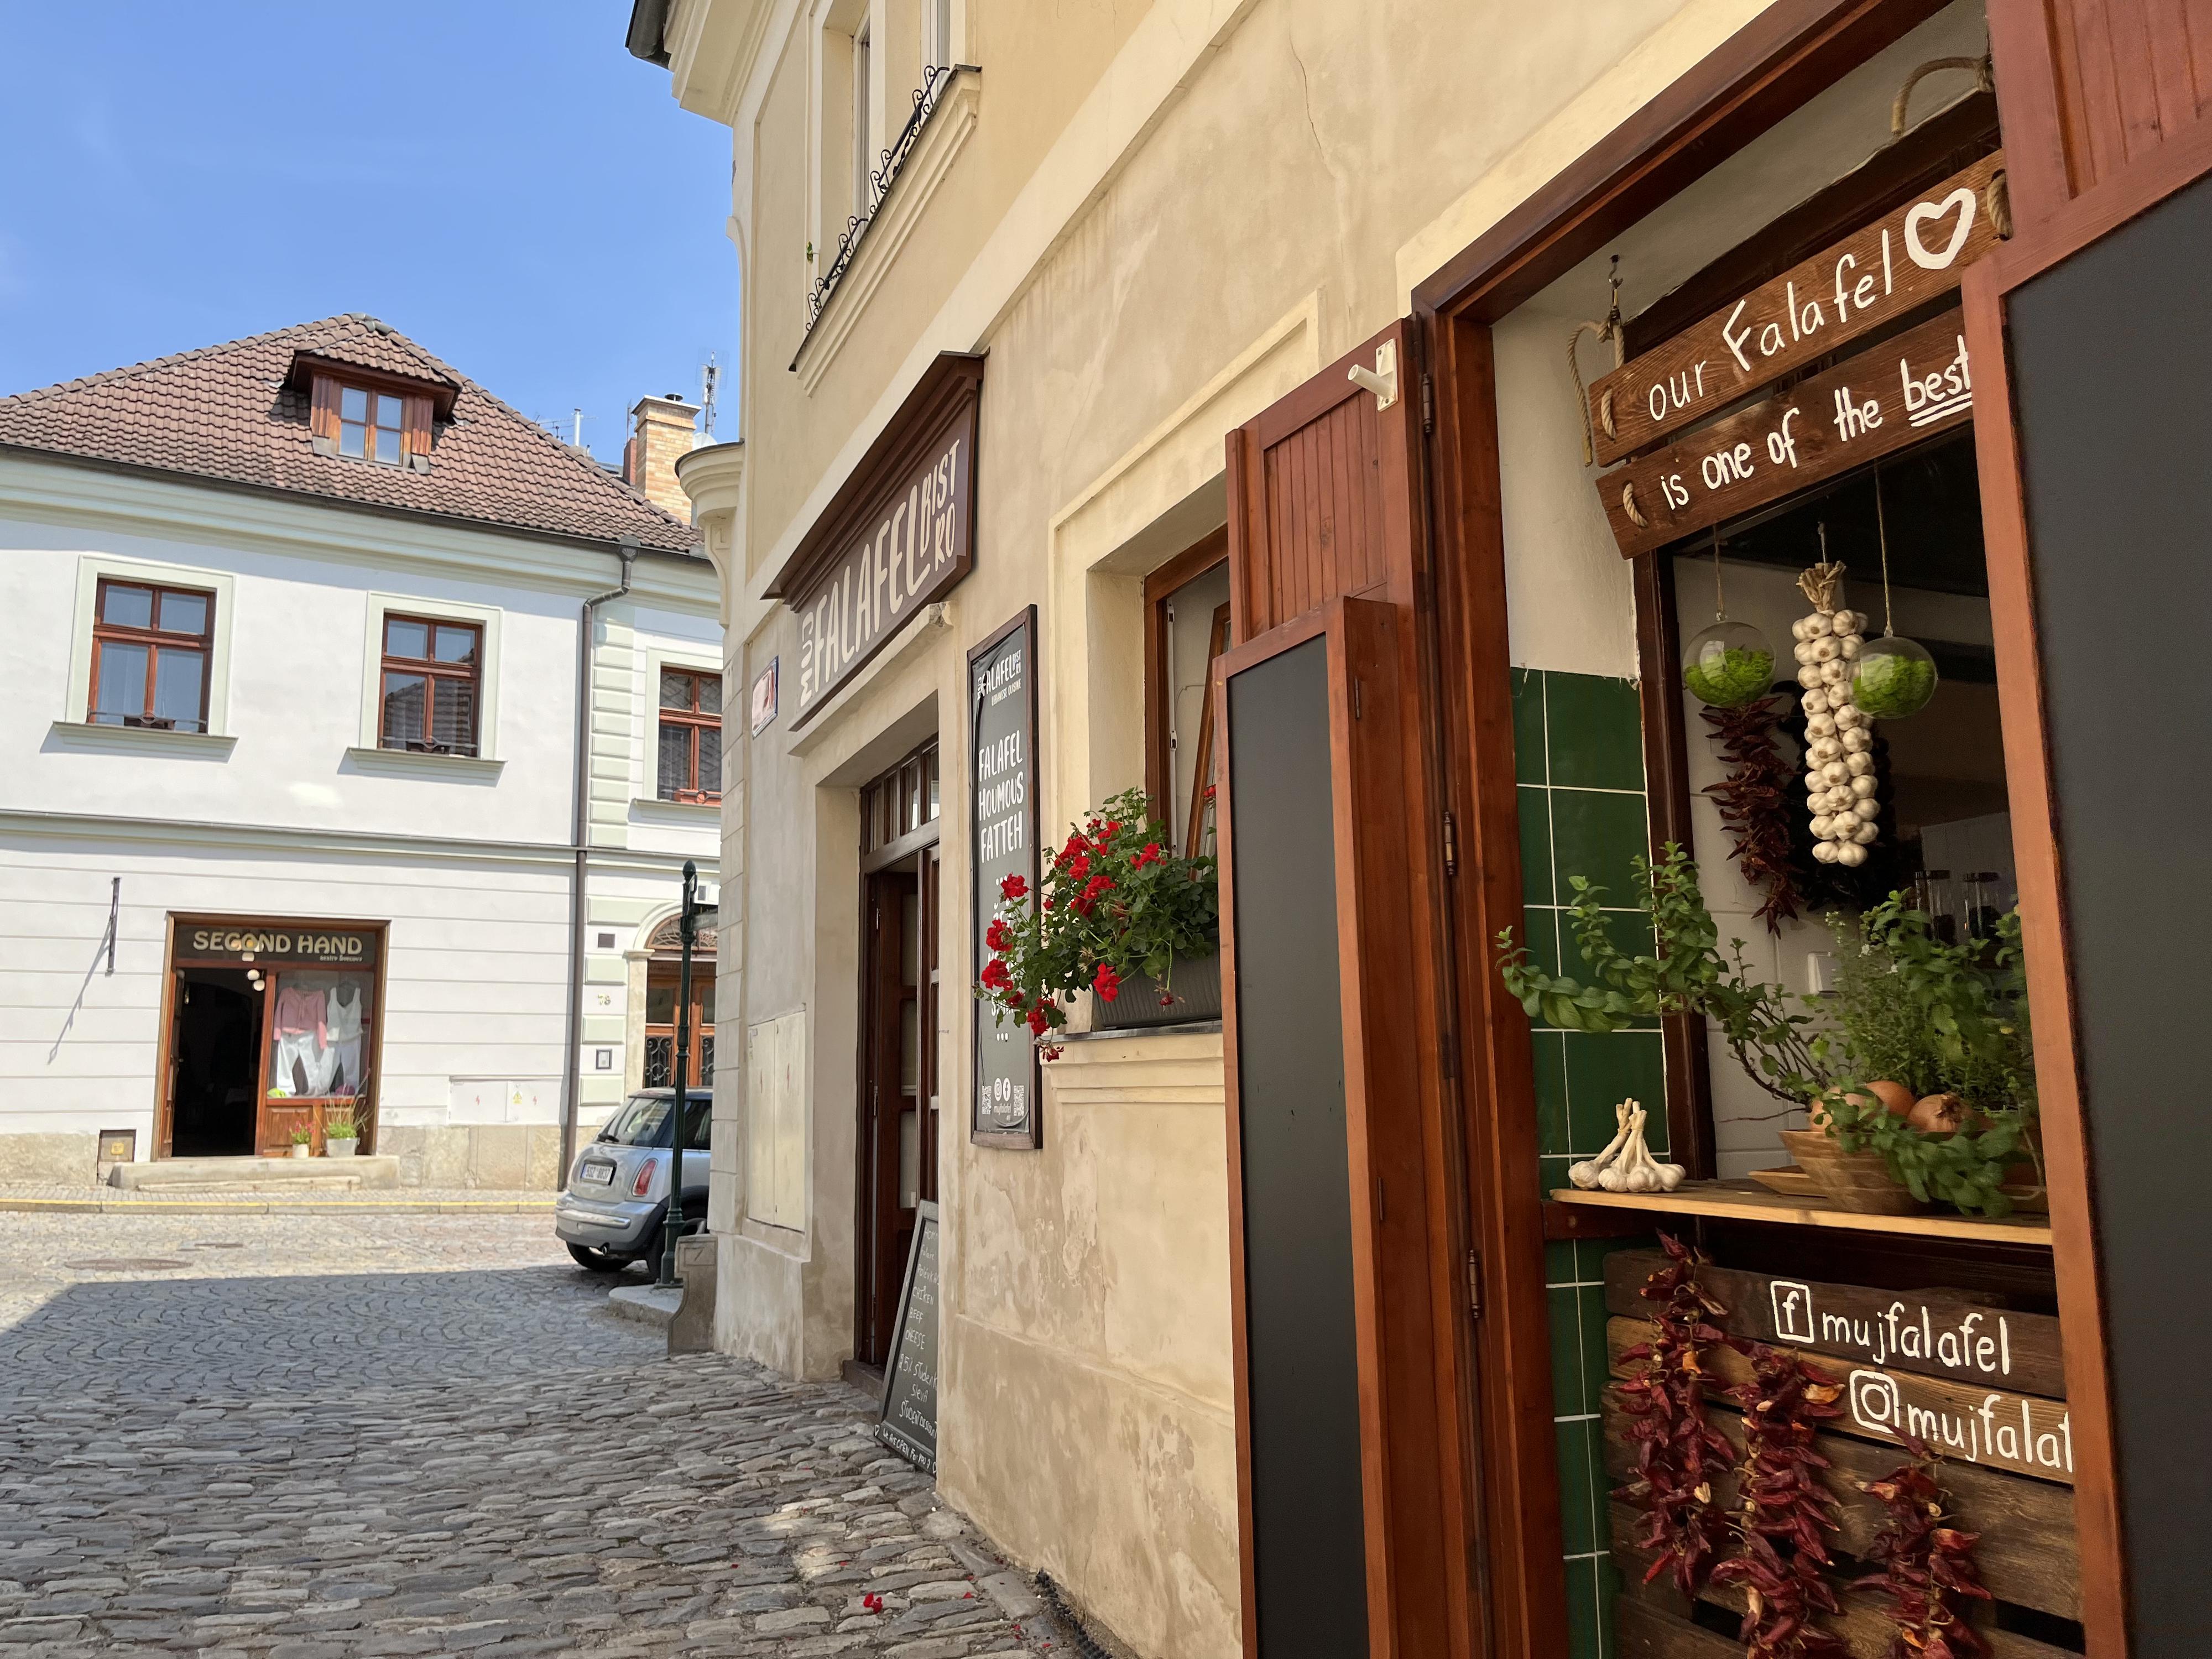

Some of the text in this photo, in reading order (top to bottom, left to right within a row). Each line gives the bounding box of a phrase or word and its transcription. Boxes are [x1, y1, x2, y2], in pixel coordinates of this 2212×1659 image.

[1648, 228, 1893, 421] our Falafel
[1661, 335, 1971, 510] is one of the best
[814, 484, 930, 693] FALAFEL
[979, 729, 1023, 782] FALAFEL
[979, 771, 1024, 821] HOUMOUS
[980, 810, 1023, 863] FATTEH
[193, 931, 363, 955] SECOND HAND
[909, 1307, 924, 1323] BEEF
[1822, 1301, 2010, 1375] mujfalafel
